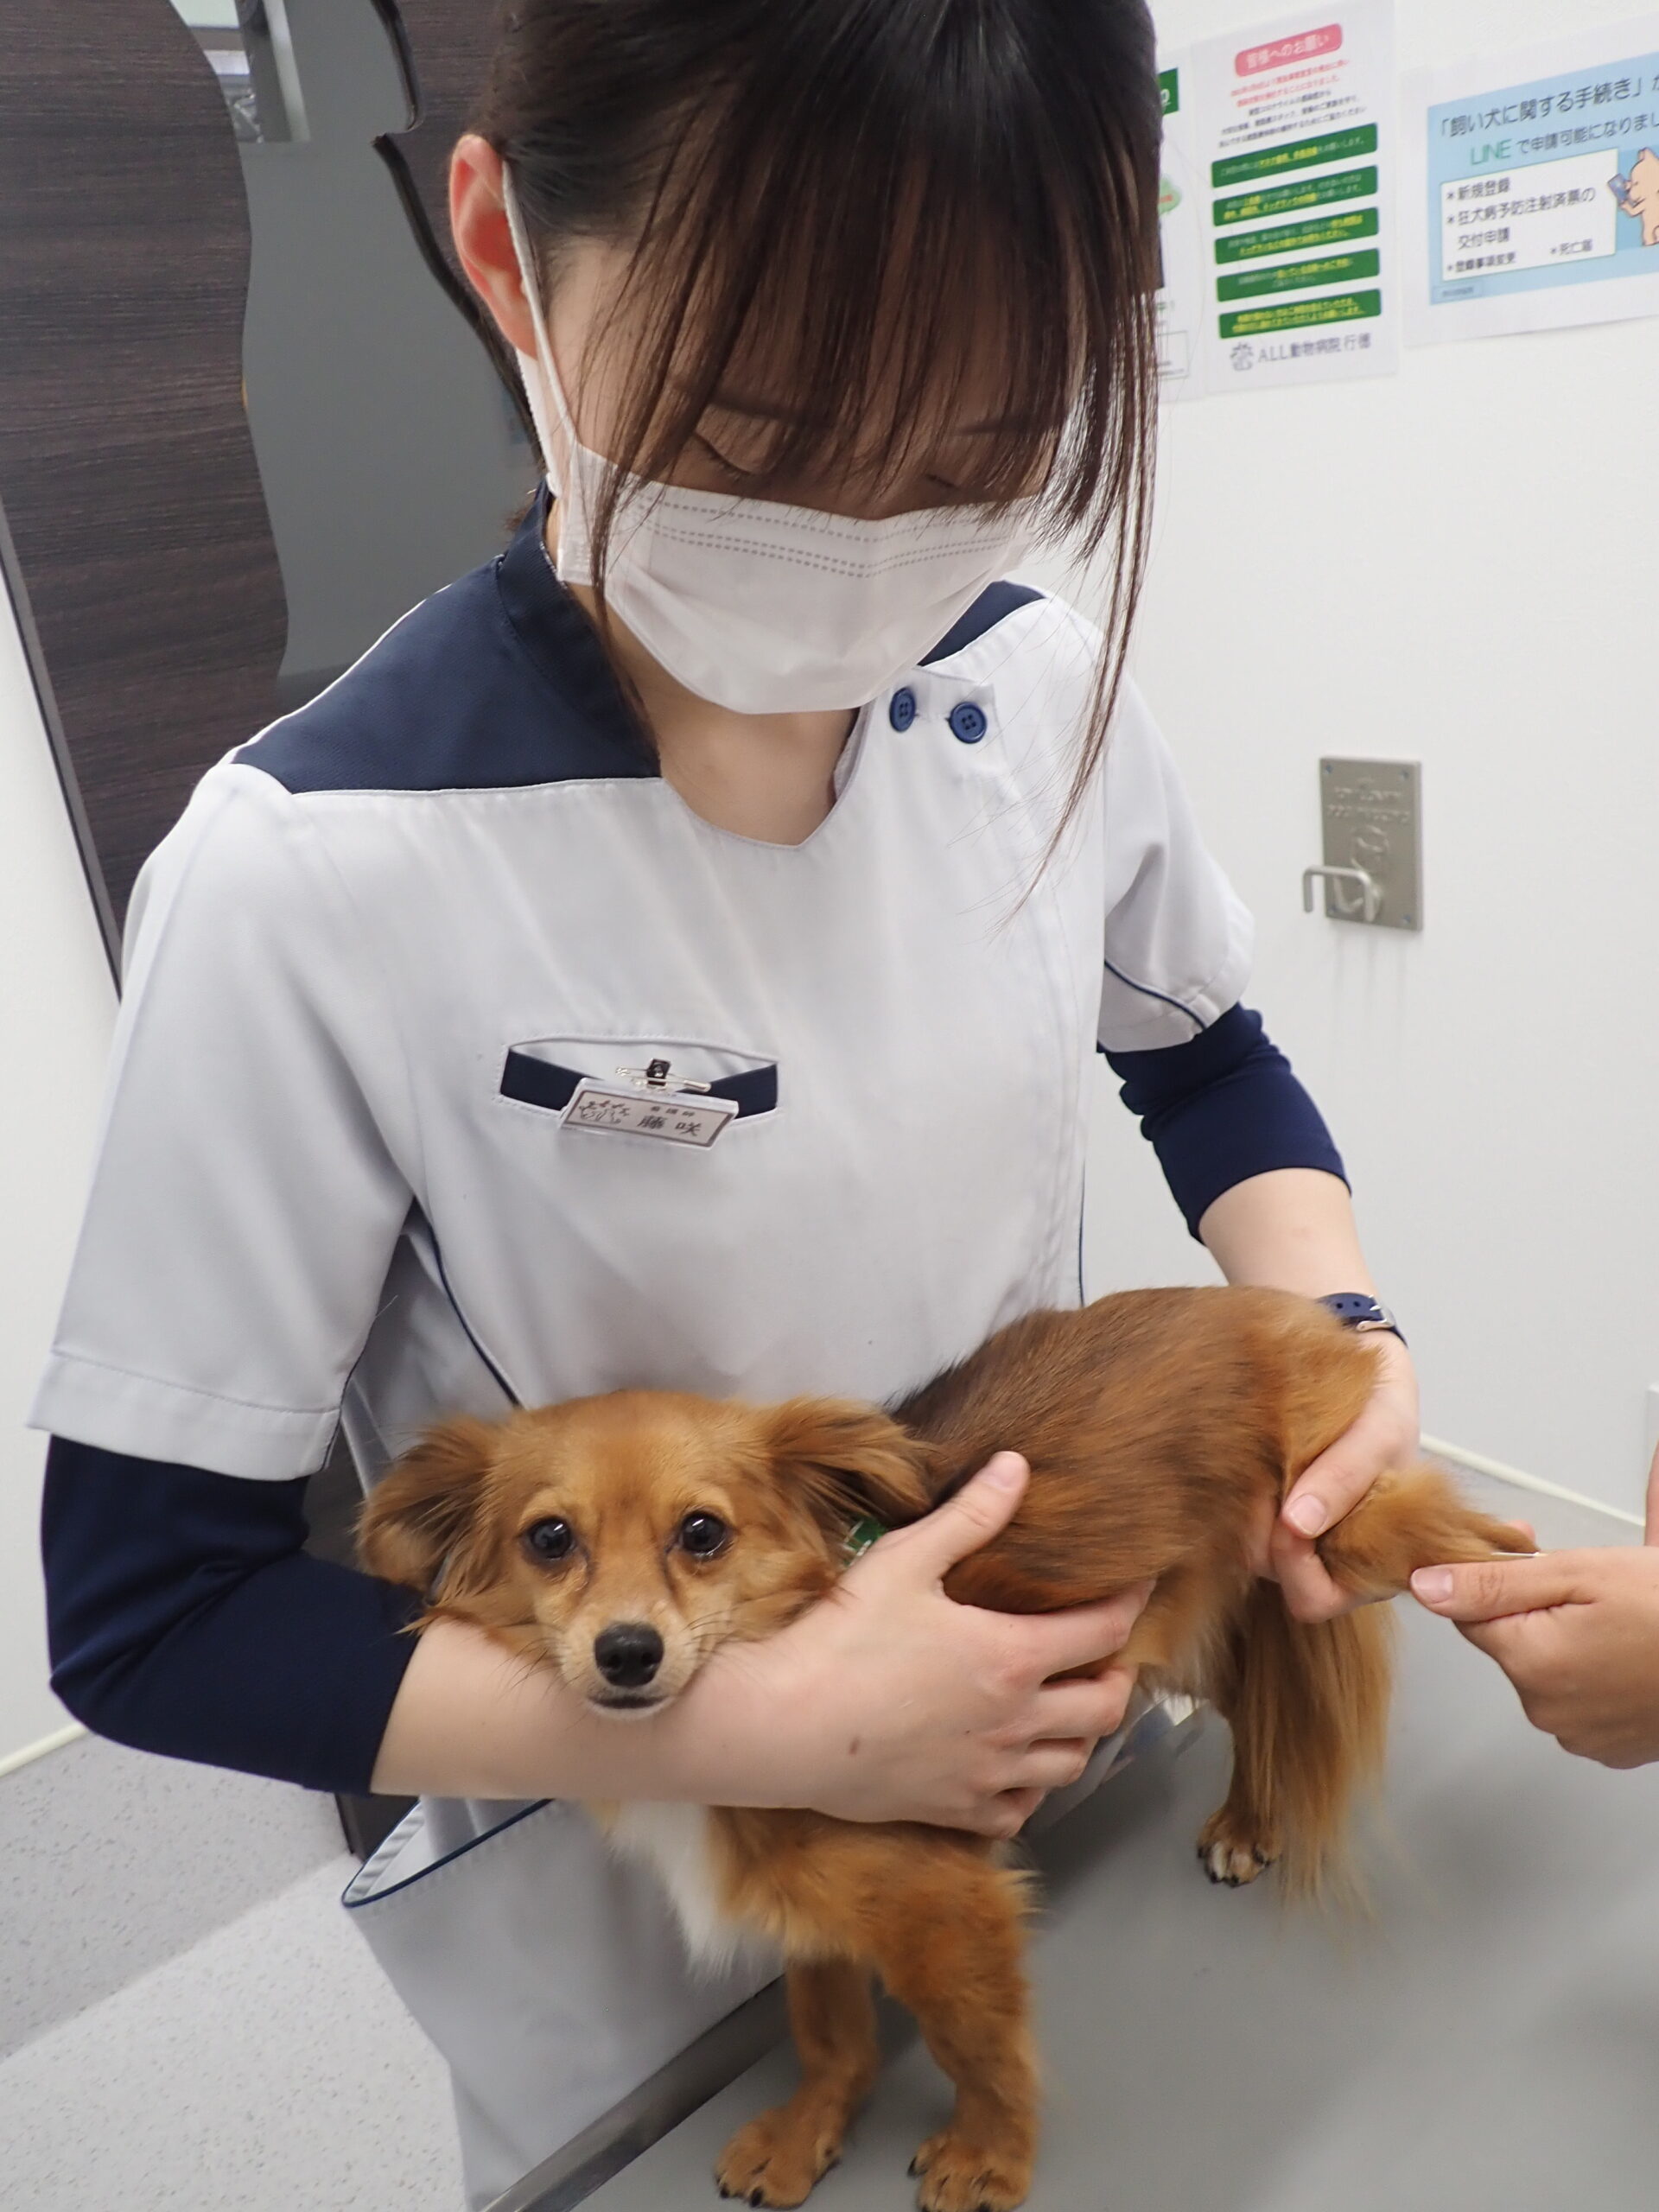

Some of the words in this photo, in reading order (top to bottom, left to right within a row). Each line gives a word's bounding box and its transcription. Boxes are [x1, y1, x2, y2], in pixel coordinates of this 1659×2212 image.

[1470, 138, 1512, 165] LINE
[1458, 177, 1510, 200] 新規登録
[1458, 227, 1510, 250] 交付申請
